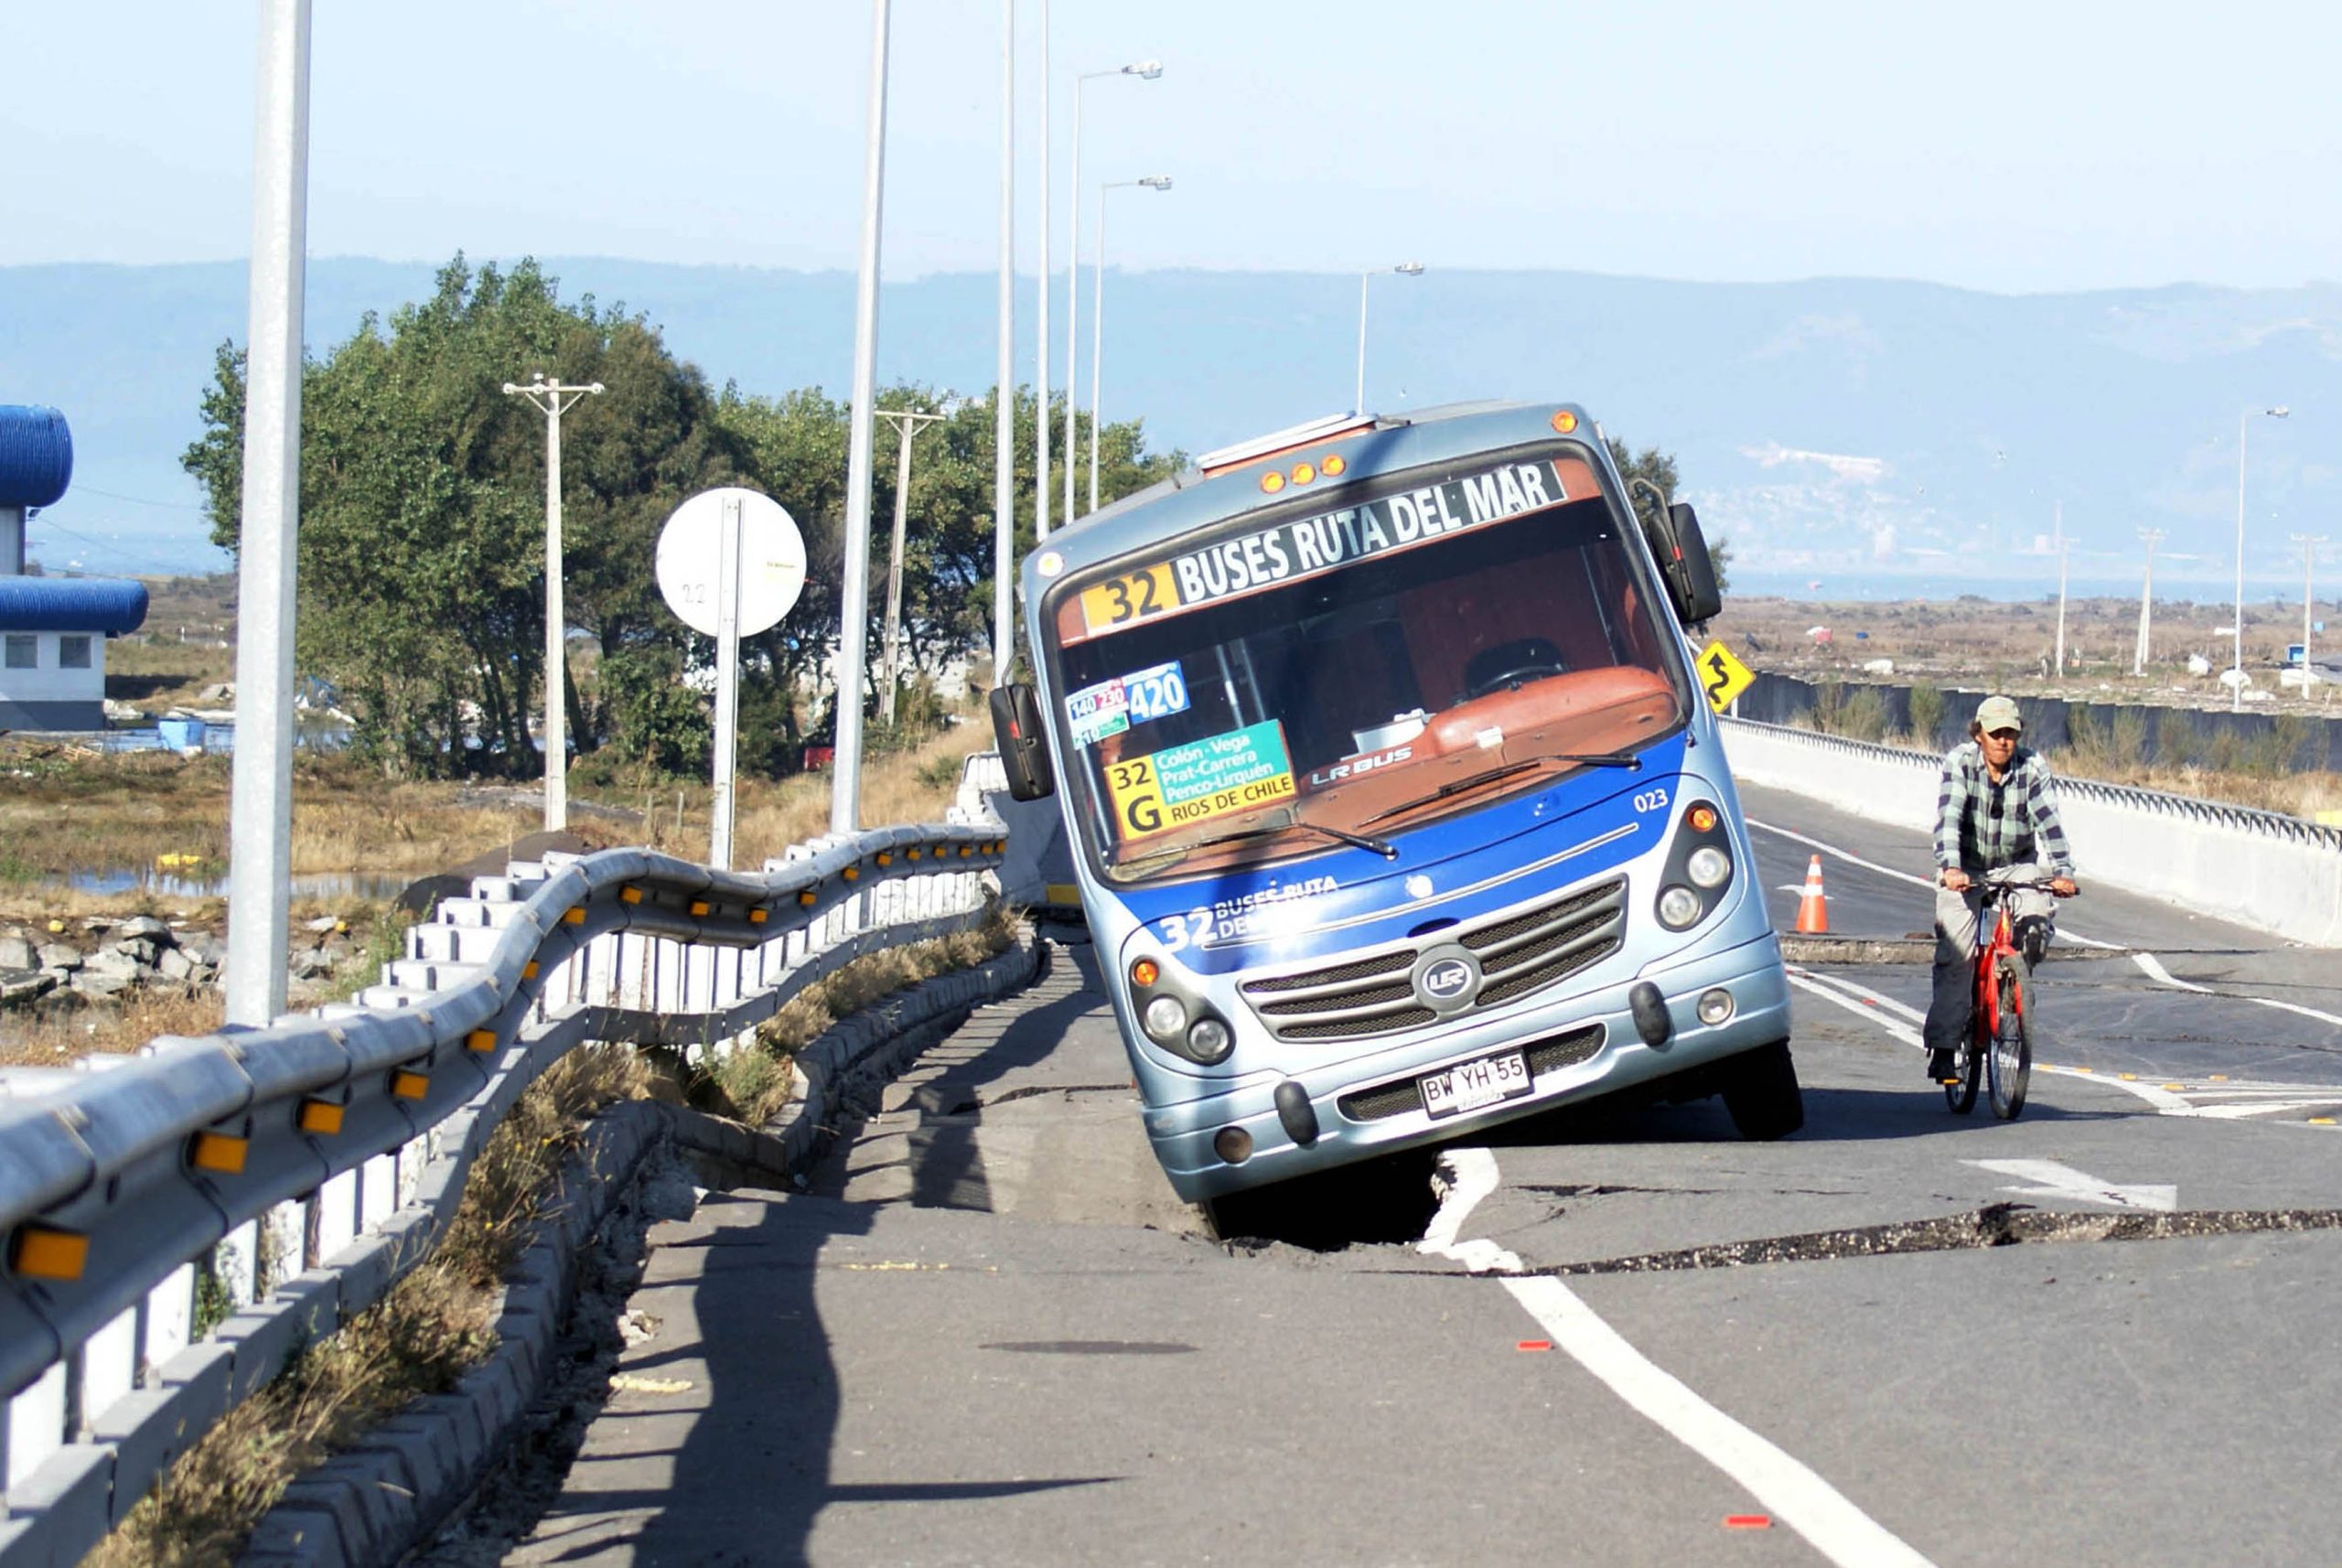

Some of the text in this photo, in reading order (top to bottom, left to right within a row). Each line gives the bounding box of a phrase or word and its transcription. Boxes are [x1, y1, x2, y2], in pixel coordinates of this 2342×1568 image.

[1111, 463, 1550, 623] 32 BUSES RUTA DEL MAR
[1070, 696, 1097, 718] 140
[1098, 687, 1126, 709] 230
[1130, 671, 1186, 718] 420
[1156, 746, 1204, 770] Colón
[1210, 735, 1251, 757] Vega
[1113, 761, 1152, 790] 32
[1127, 794, 1163, 832] G
[1171, 777, 1293, 822] RIOS DE CHILE
[1633, 789, 1669, 813] 023
[1214, 875, 1338, 920] BUSES RUTA
[1159, 907, 1219, 953] 32
[1425, 1058, 1523, 1101] BW YH 55
